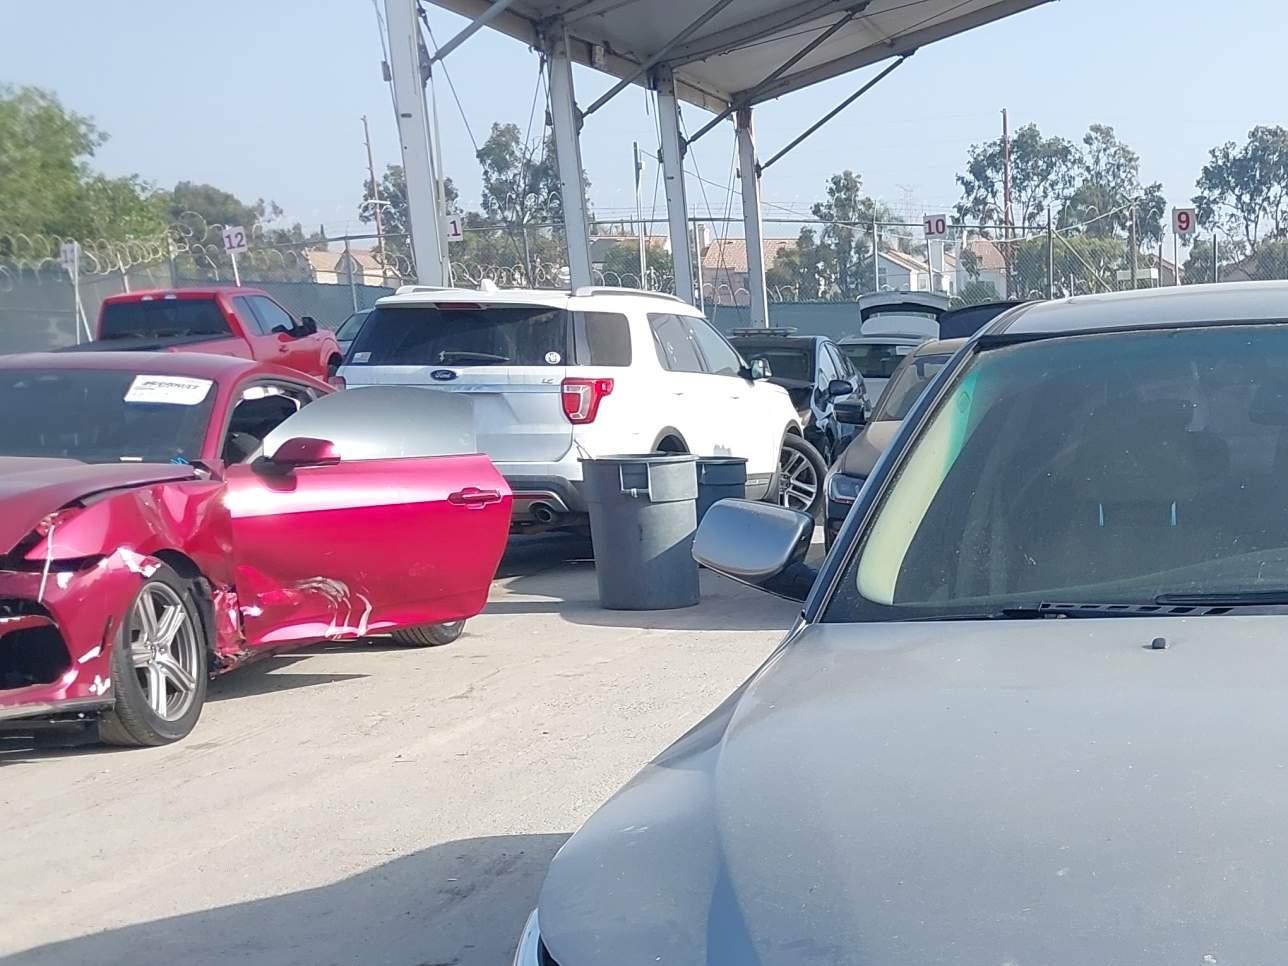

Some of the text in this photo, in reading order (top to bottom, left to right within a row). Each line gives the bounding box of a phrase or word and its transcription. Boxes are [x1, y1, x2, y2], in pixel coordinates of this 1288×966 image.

[924, 218, 946, 235] 10
[1177, 211, 1190, 231] 9
[224, 231, 245, 250] 12
